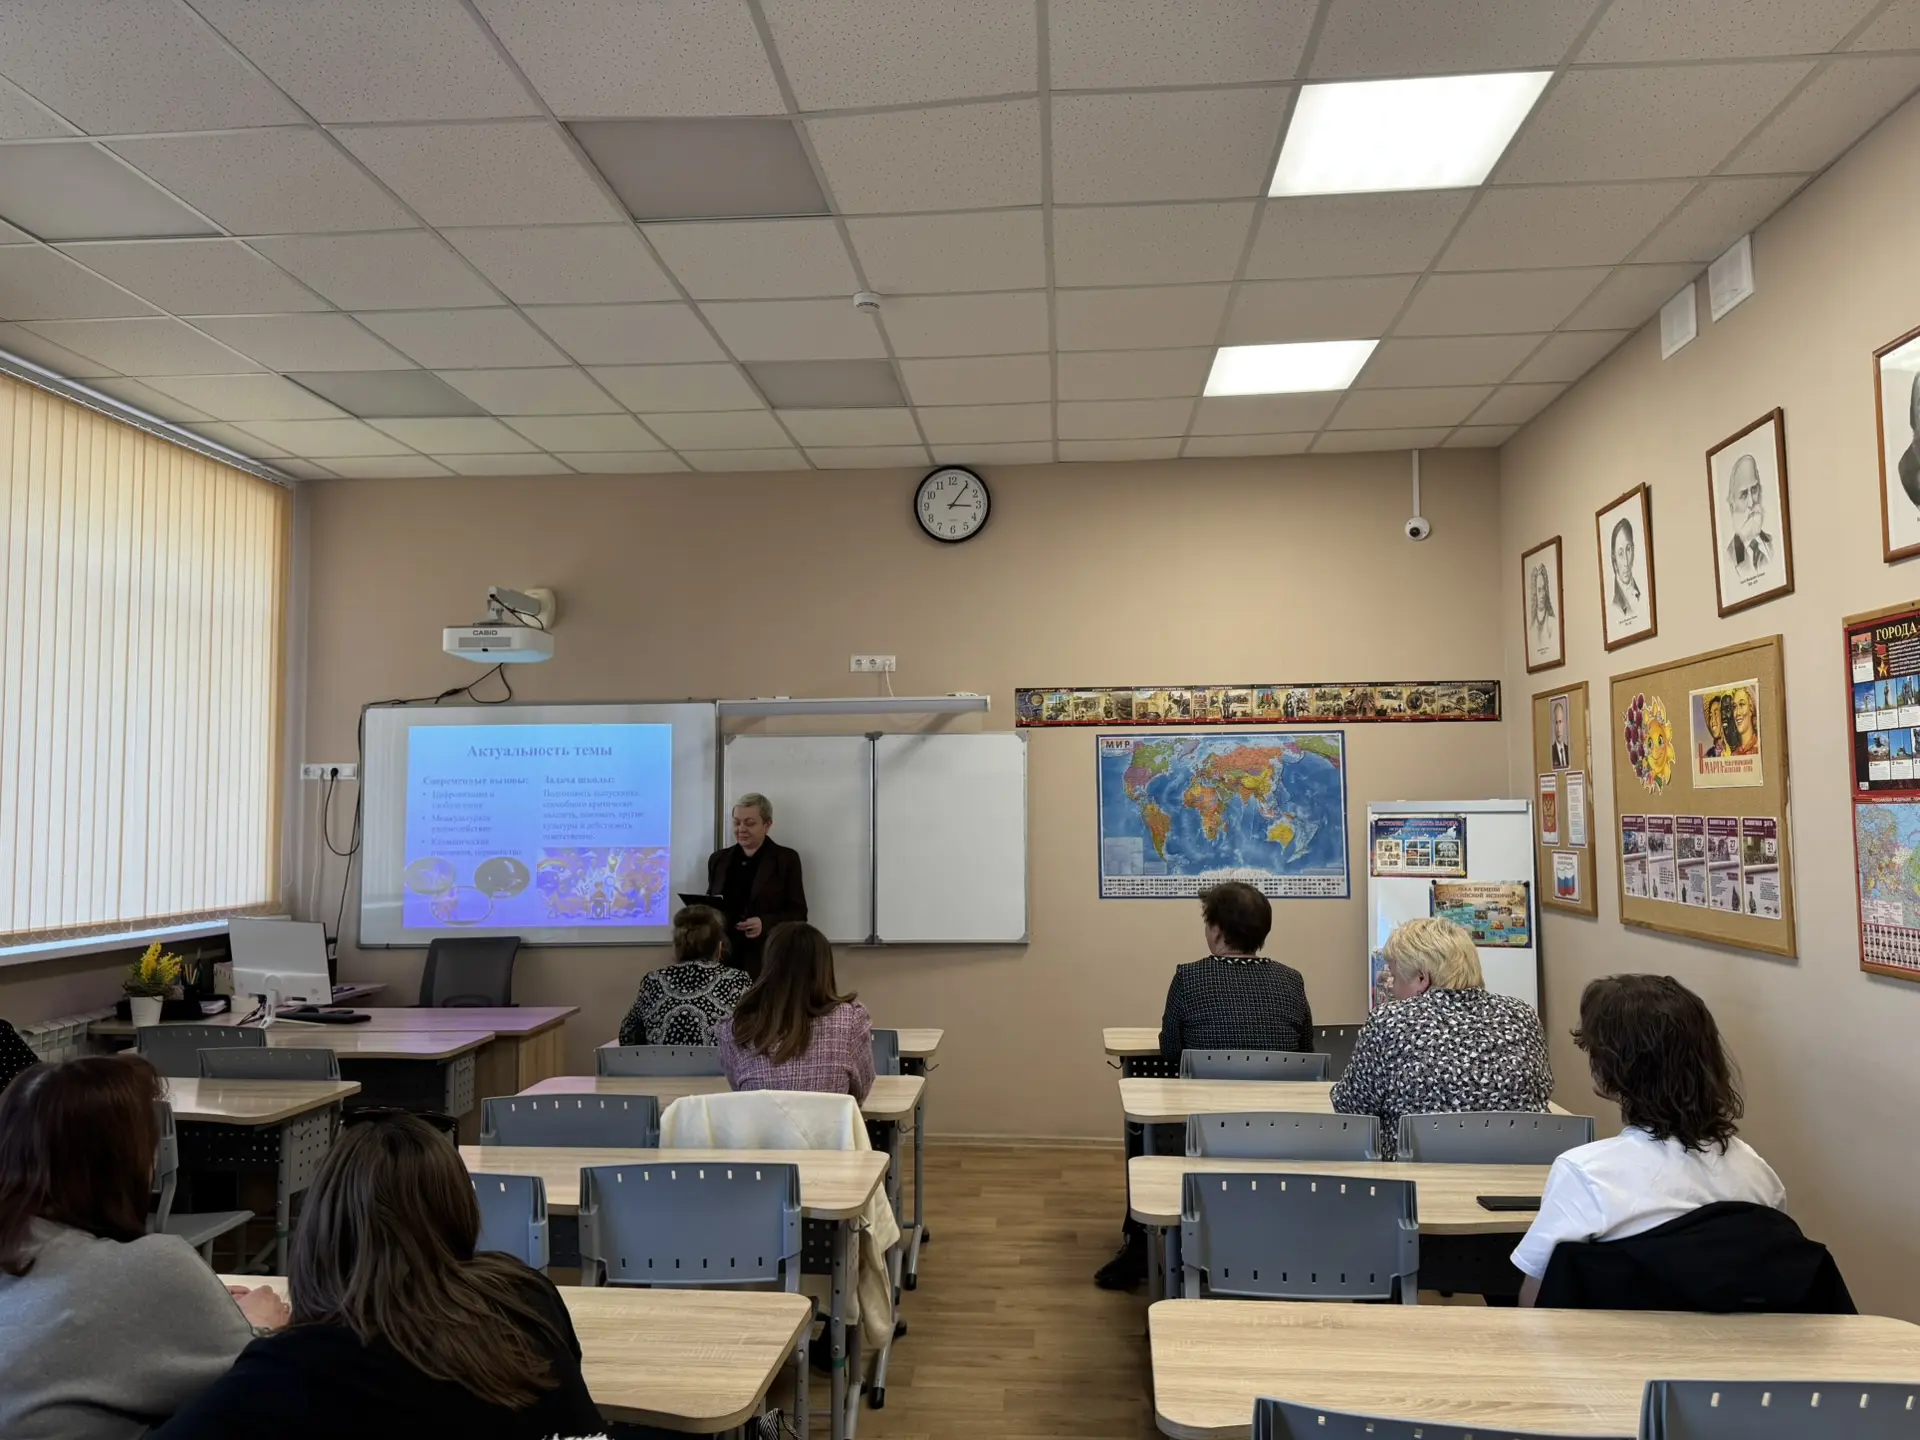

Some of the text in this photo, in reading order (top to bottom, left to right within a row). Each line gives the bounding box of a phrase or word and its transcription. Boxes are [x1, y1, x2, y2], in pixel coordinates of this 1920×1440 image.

[936, 481, 944, 490] 11
[948, 476, 958, 486] 12
[927, 491, 936, 500] 10
[972, 489, 979, 498] 2
[923, 503, 930, 511] 9
[975, 500, 982, 510] 3
[928, 514, 934, 523] 8
[971, 512, 977, 522] 4
[937, 522, 943, 531] 7
[949, 525, 956, 534] 6
[963, 522, 969, 531] 5
[1105, 740, 1130, 749] МИР
[467, 744, 613, 760] Актуальность темы
[545, 775, 615, 784] Задача школы:
